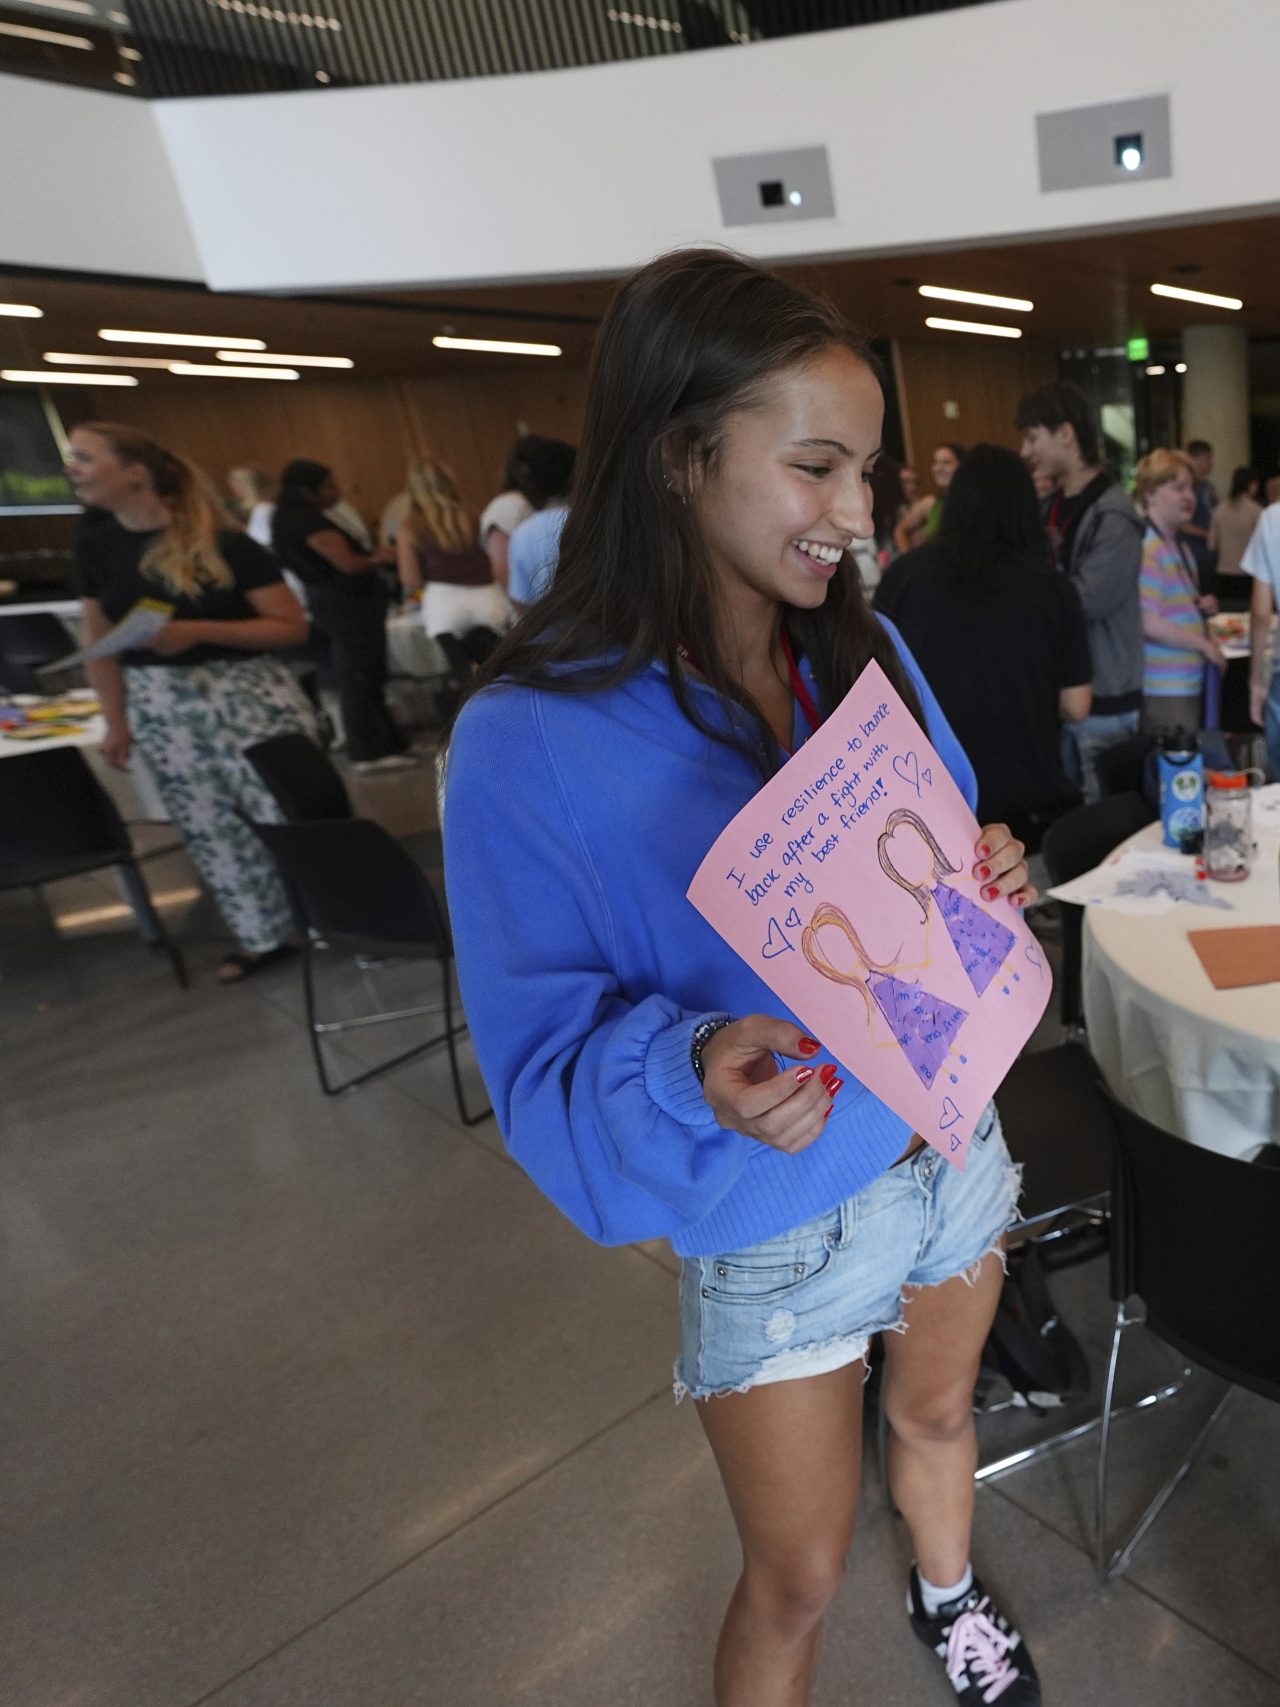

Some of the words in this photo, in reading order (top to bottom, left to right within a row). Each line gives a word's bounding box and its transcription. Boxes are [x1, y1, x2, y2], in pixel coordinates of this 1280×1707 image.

[726, 866, 746, 889] I
[749, 832, 774, 859] use
[781, 757, 846, 826] resilience
[847, 737, 863, 753] to
[859, 702, 890, 737] bounce
[745, 868, 781, 906] back
[782, 826, 816, 866] after
[817, 812, 830, 826] a
[830, 771, 863, 808] fight
[863, 742, 889, 772] with
[784, 872, 814, 898] my
[811, 833, 841, 863] best
[839, 777, 889, 830] friend!
